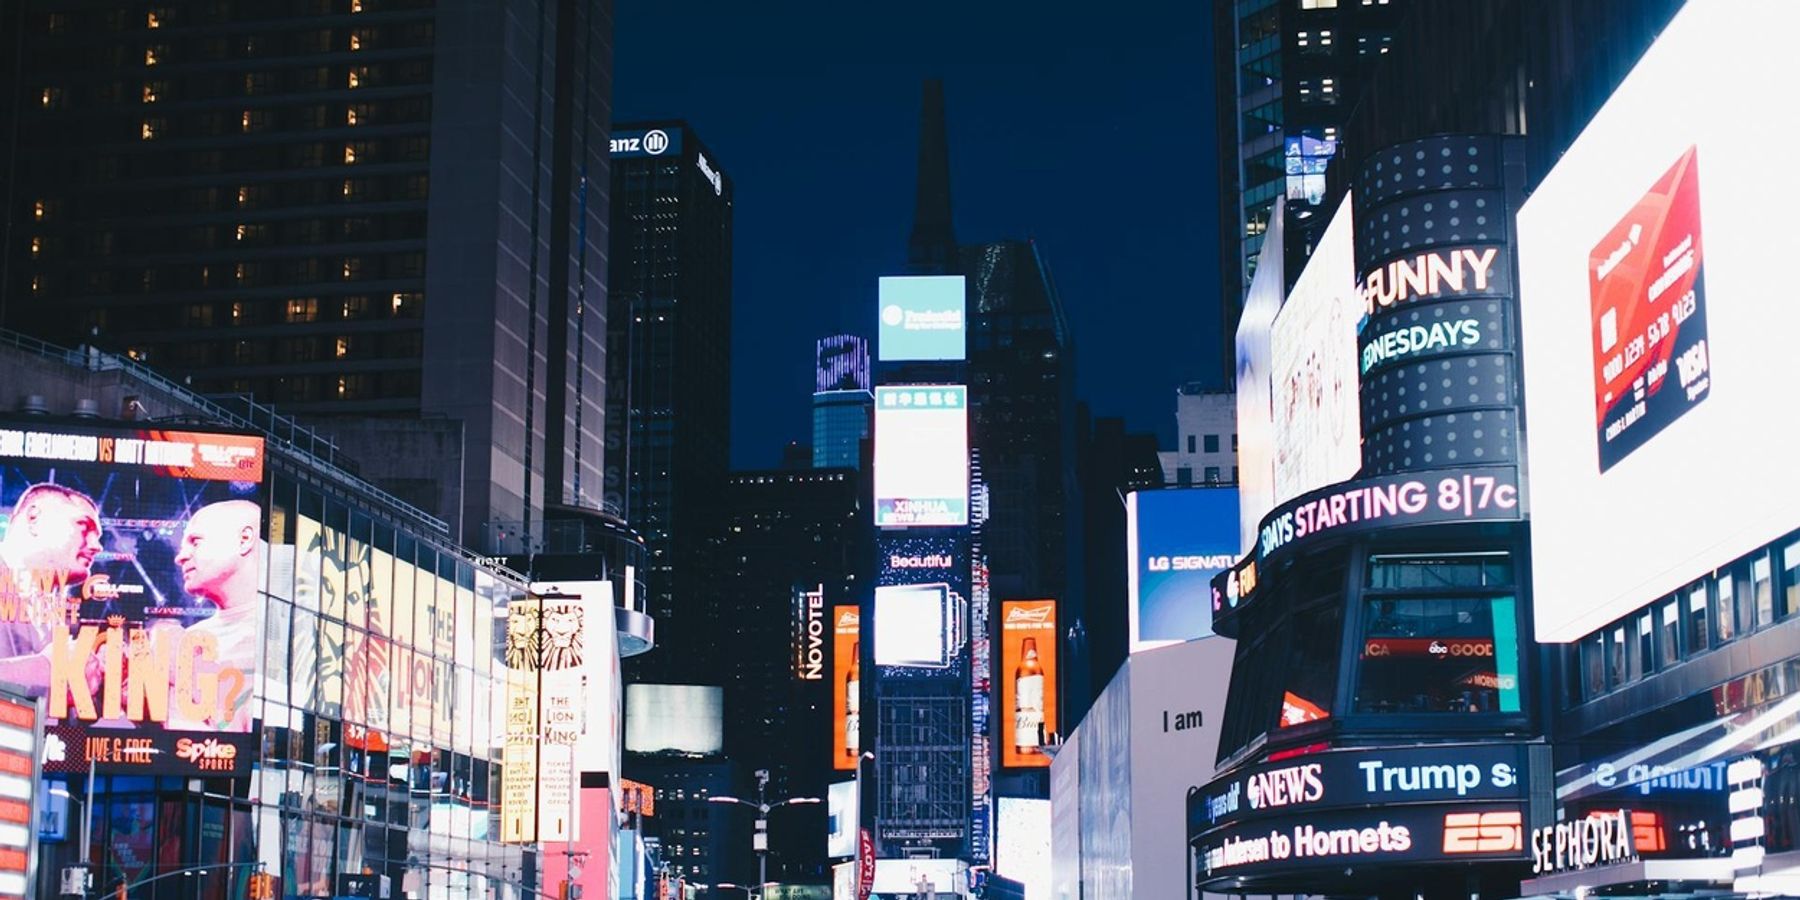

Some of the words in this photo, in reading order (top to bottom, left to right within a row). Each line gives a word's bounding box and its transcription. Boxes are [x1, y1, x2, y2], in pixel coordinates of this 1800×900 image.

[609, 138, 640, 153] anz
[1367, 248, 1497, 315] FUNNY
[1676, 340, 1708, 388] VISA
[98, 437, 114, 462] VS
[894, 500, 948, 513] XINHUA
[1295, 482, 1428, 537] STARTING
[891, 555, 952, 568] Beautiful
[1148, 556, 1170, 571] LG
[428, 604, 453, 643] THE
[806, 583, 824, 680] NOVOTEL
[1428, 641, 1448, 654] abc
[47, 624, 245, 728] KING?
[397, 634, 439, 709] LION
[551, 696, 569, 706] THE
[546, 708, 574, 725] LION
[1163, 710, 1169, 733] I
[1175, 710, 1203, 731] am
[544, 726, 578, 746] KING
[85, 737, 110, 762] LIVE
[112, 738, 122, 761] &
[125, 738, 153, 763] FREE
[175, 737, 237, 762] Spike
[198, 758, 235, 771] SPORTS
[1259, 763, 1324, 808] NEWS
[1358, 760, 1482, 796] Trump
[1491, 762, 1518, 788] s
[1270, 830, 1291, 859] to
[1294, 821, 1411, 858] Hornets
[1442, 810, 1523, 853] ES
[1531, 808, 1631, 874] SEPHORA
